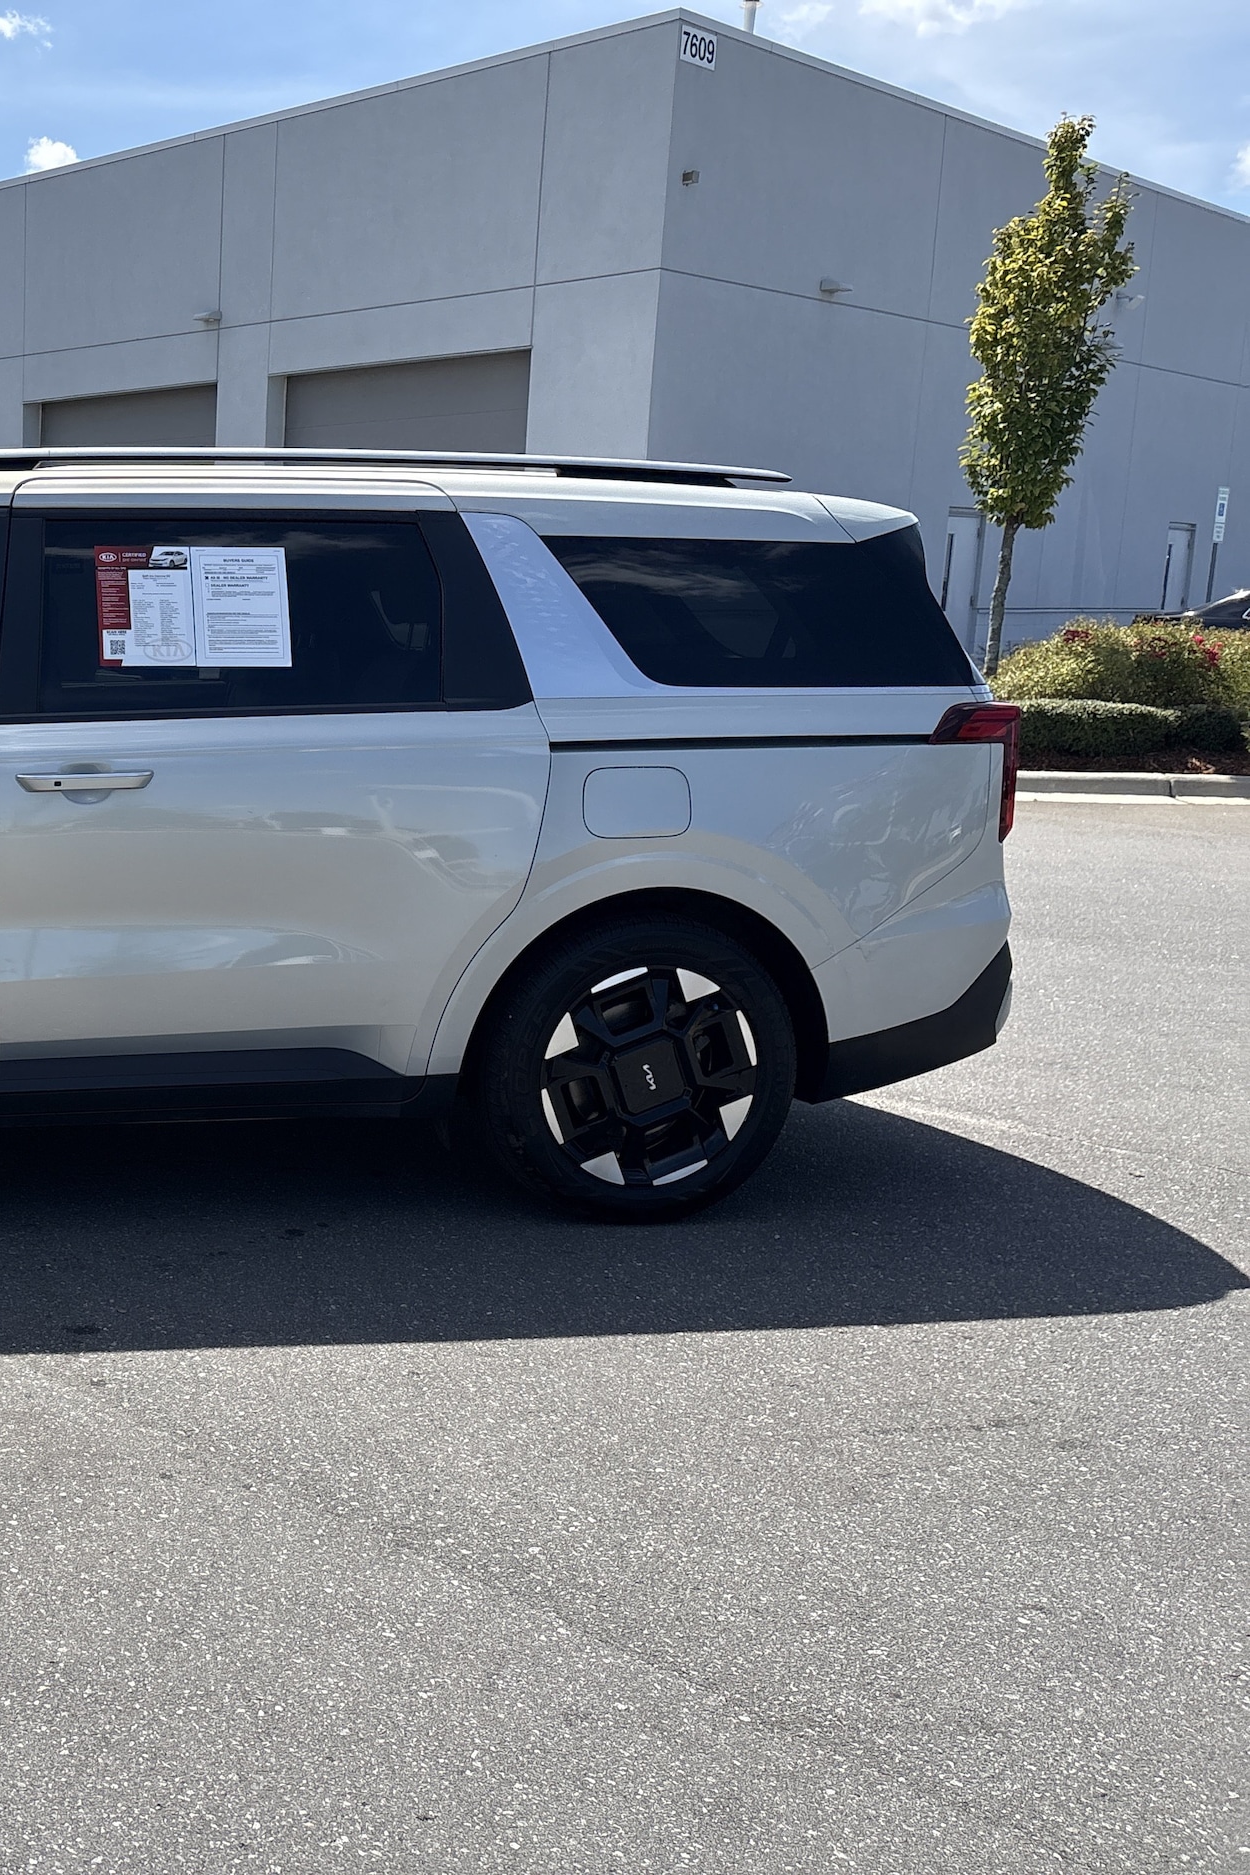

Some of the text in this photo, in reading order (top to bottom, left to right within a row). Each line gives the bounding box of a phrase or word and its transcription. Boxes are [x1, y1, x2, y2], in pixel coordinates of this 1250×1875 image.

[683, 30, 715, 64] 7609
[100, 553, 116, 561] KIA
[152, 644, 185, 657] KIA
